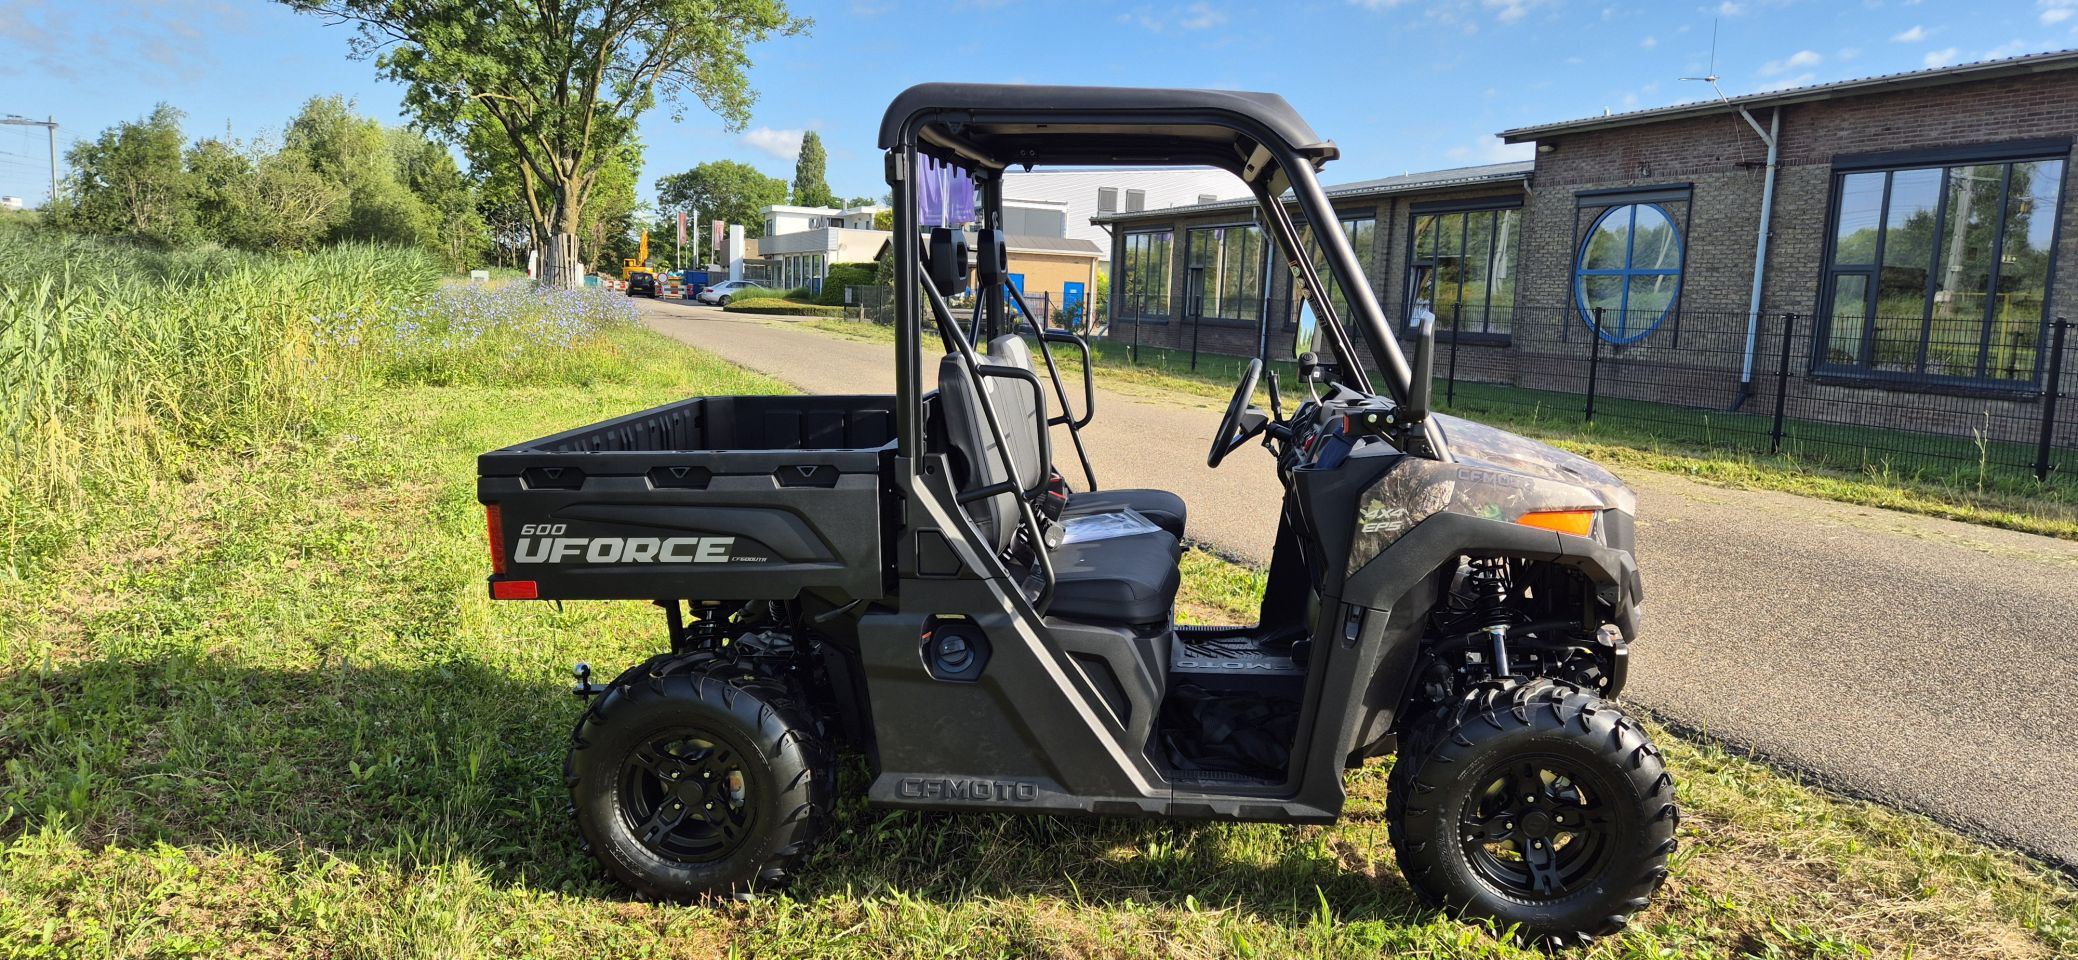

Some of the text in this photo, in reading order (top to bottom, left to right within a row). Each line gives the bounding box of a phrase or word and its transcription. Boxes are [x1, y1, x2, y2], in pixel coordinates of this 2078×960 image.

[520, 523, 568, 536] 600
[1361, 521, 1403, 533] EPS
[513, 536, 736, 564] UFORCE
[900, 777, 1040, 801] CFMOTO
